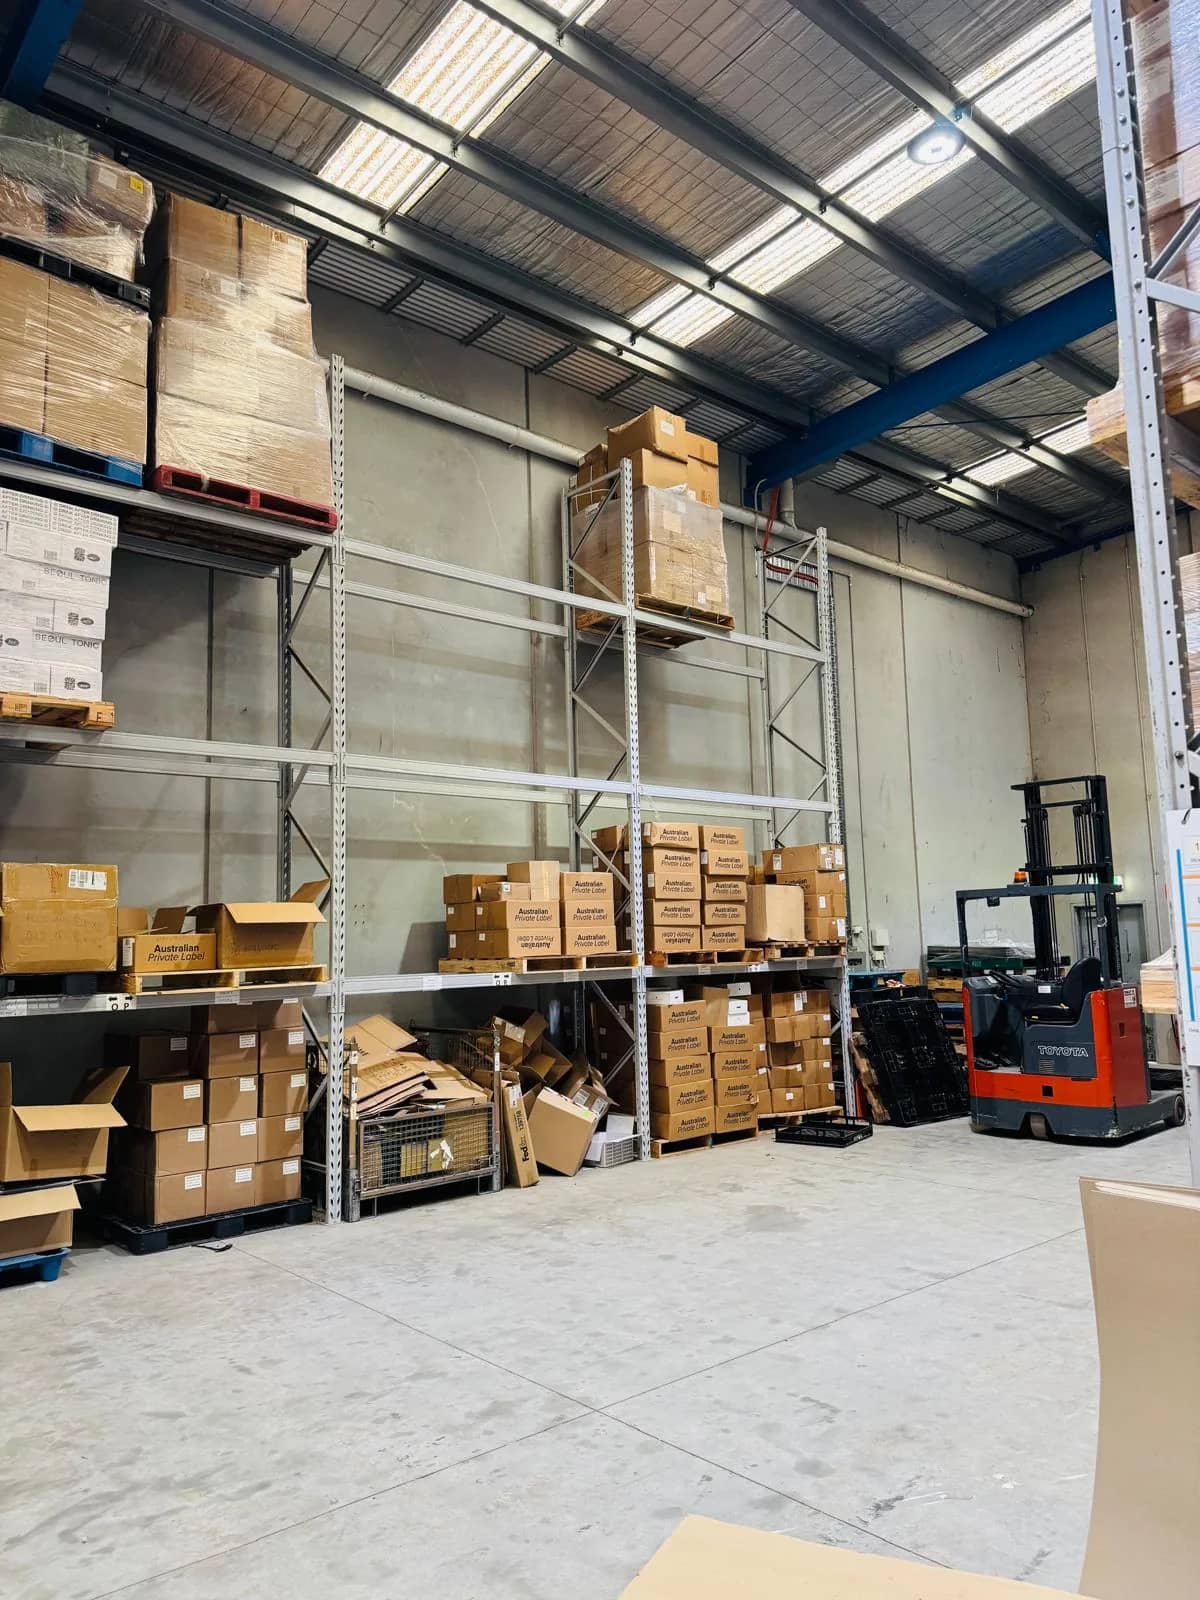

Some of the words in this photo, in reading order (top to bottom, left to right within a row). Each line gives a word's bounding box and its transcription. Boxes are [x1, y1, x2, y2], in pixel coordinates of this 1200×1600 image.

[72, 639, 100, 650] TONIC
[663, 828, 689, 836] Australian
[665, 854, 691, 862] Australian
[718, 856, 741, 864] Australian
[665, 880, 692, 888] Australian
[665, 937, 691, 945] Australian
[153, 943, 200, 953] Australian
[521, 942, 551, 950] Australian
[147, 952, 179, 962] Private
[180, 951, 206, 961] Label
[671, 1009, 698, 1018] Australian
[671, 1036, 698, 1045] Australian
[1037, 1045, 1089, 1058] TOYOTA
[676, 1062, 702, 1071] Australian
[681, 1116, 707, 1126] Australian
